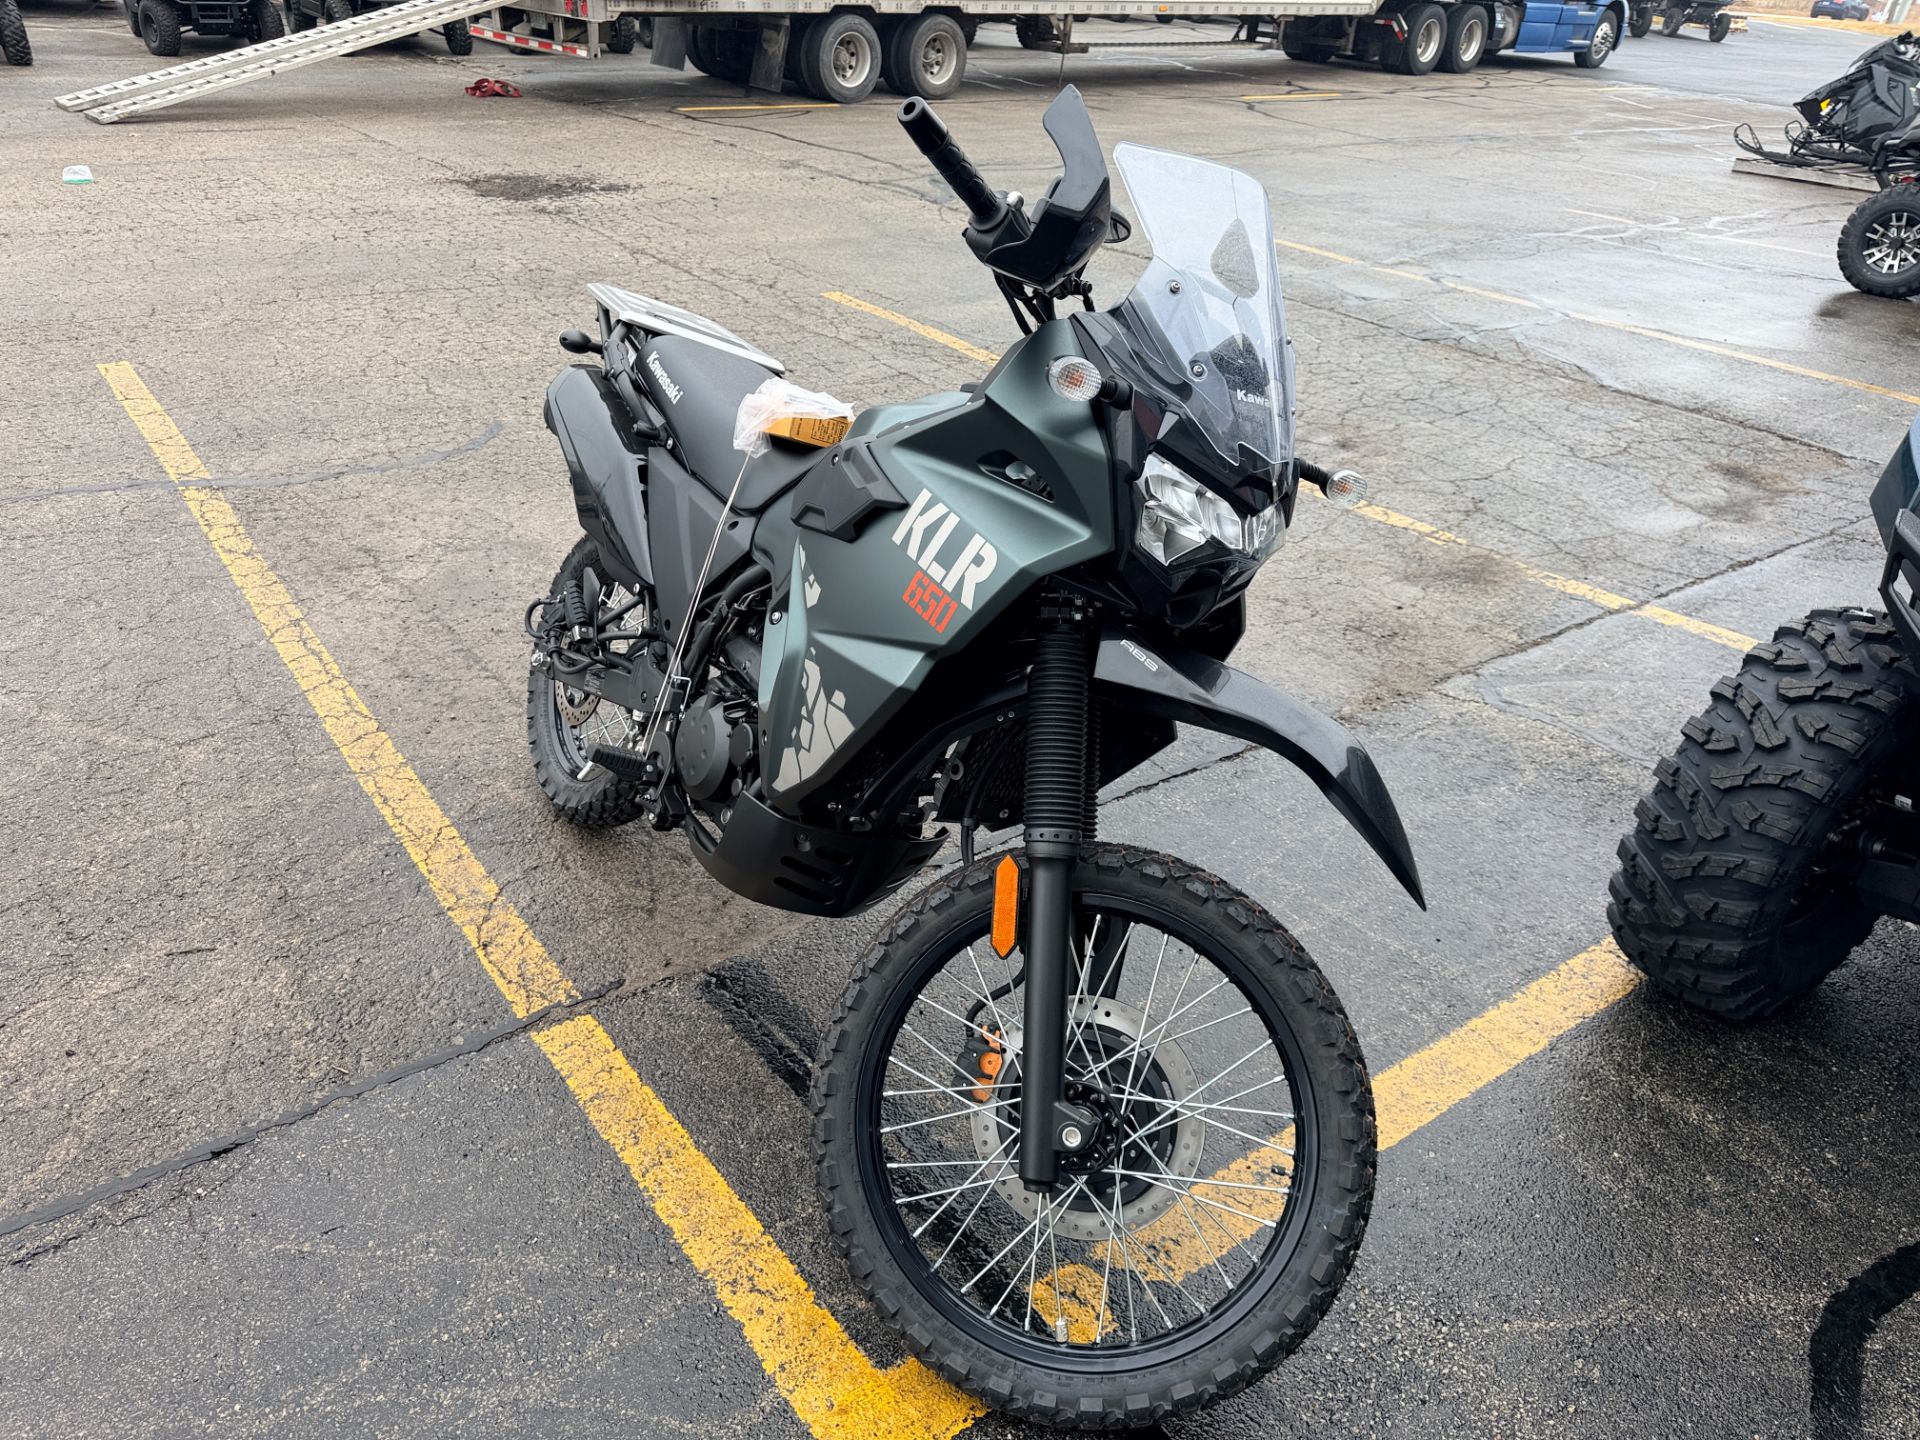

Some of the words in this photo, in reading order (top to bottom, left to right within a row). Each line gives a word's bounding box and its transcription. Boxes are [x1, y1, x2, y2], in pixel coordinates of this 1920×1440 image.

[646, 350, 684, 405] Kawasaki
[891, 487, 998, 611] KLR
[902, 569, 958, 633] 650
[1120, 639, 1159, 672] ABS
